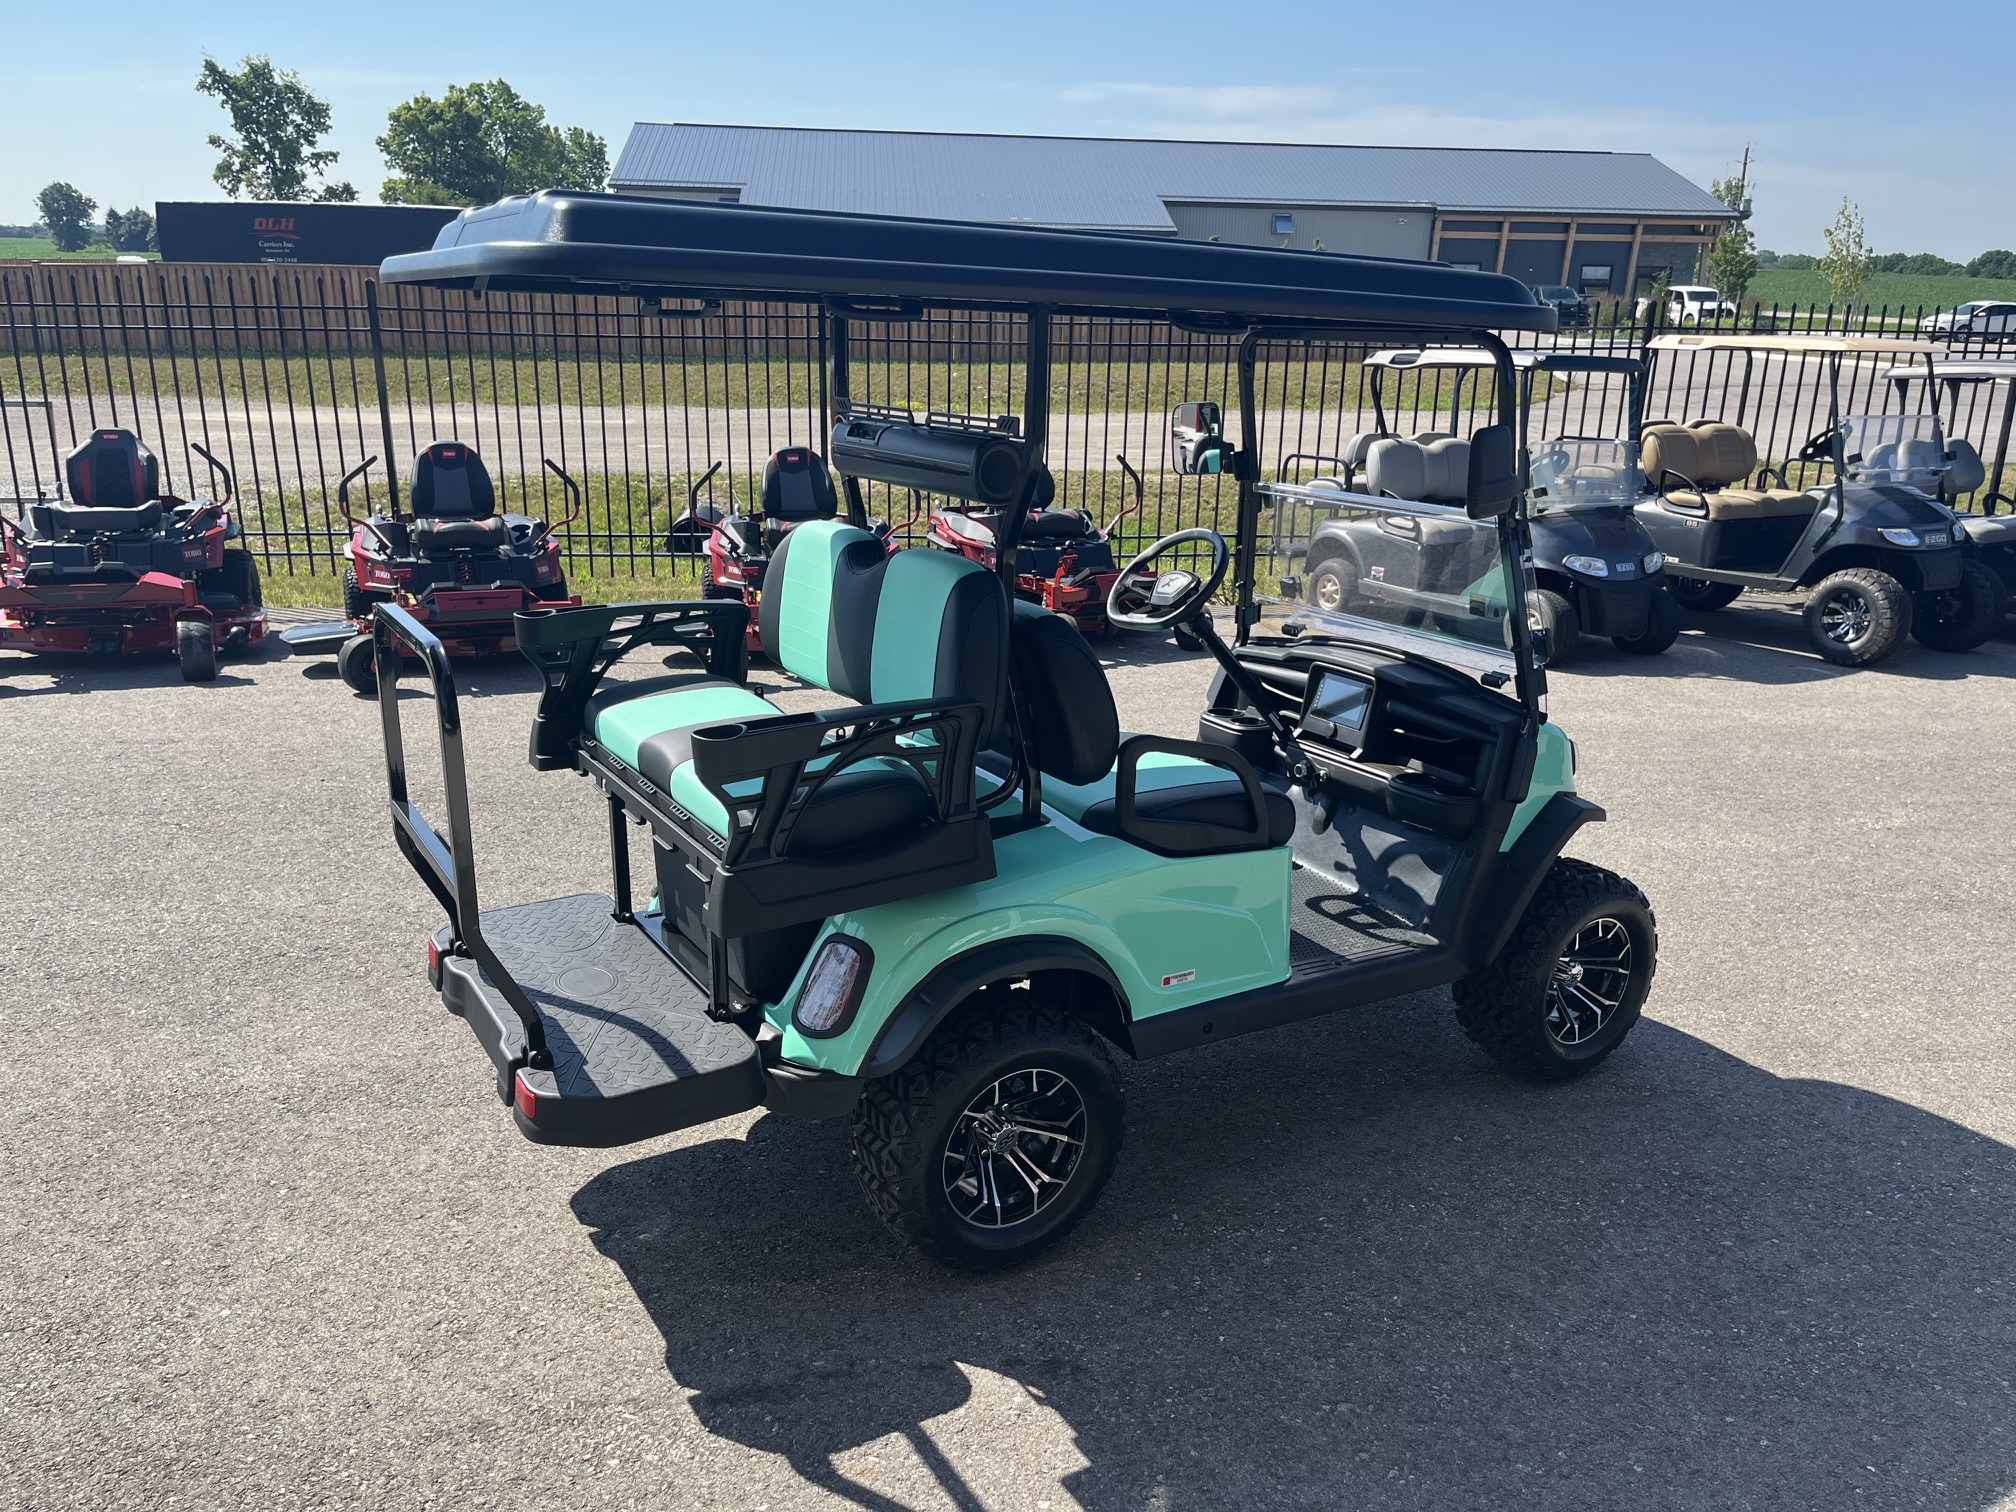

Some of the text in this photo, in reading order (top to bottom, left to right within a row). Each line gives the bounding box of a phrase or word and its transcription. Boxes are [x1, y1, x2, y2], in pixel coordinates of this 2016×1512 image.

[252, 217, 296, 231] DLH
[183, 549, 202, 558] TORO
[375, 570, 391, 579] TORO
